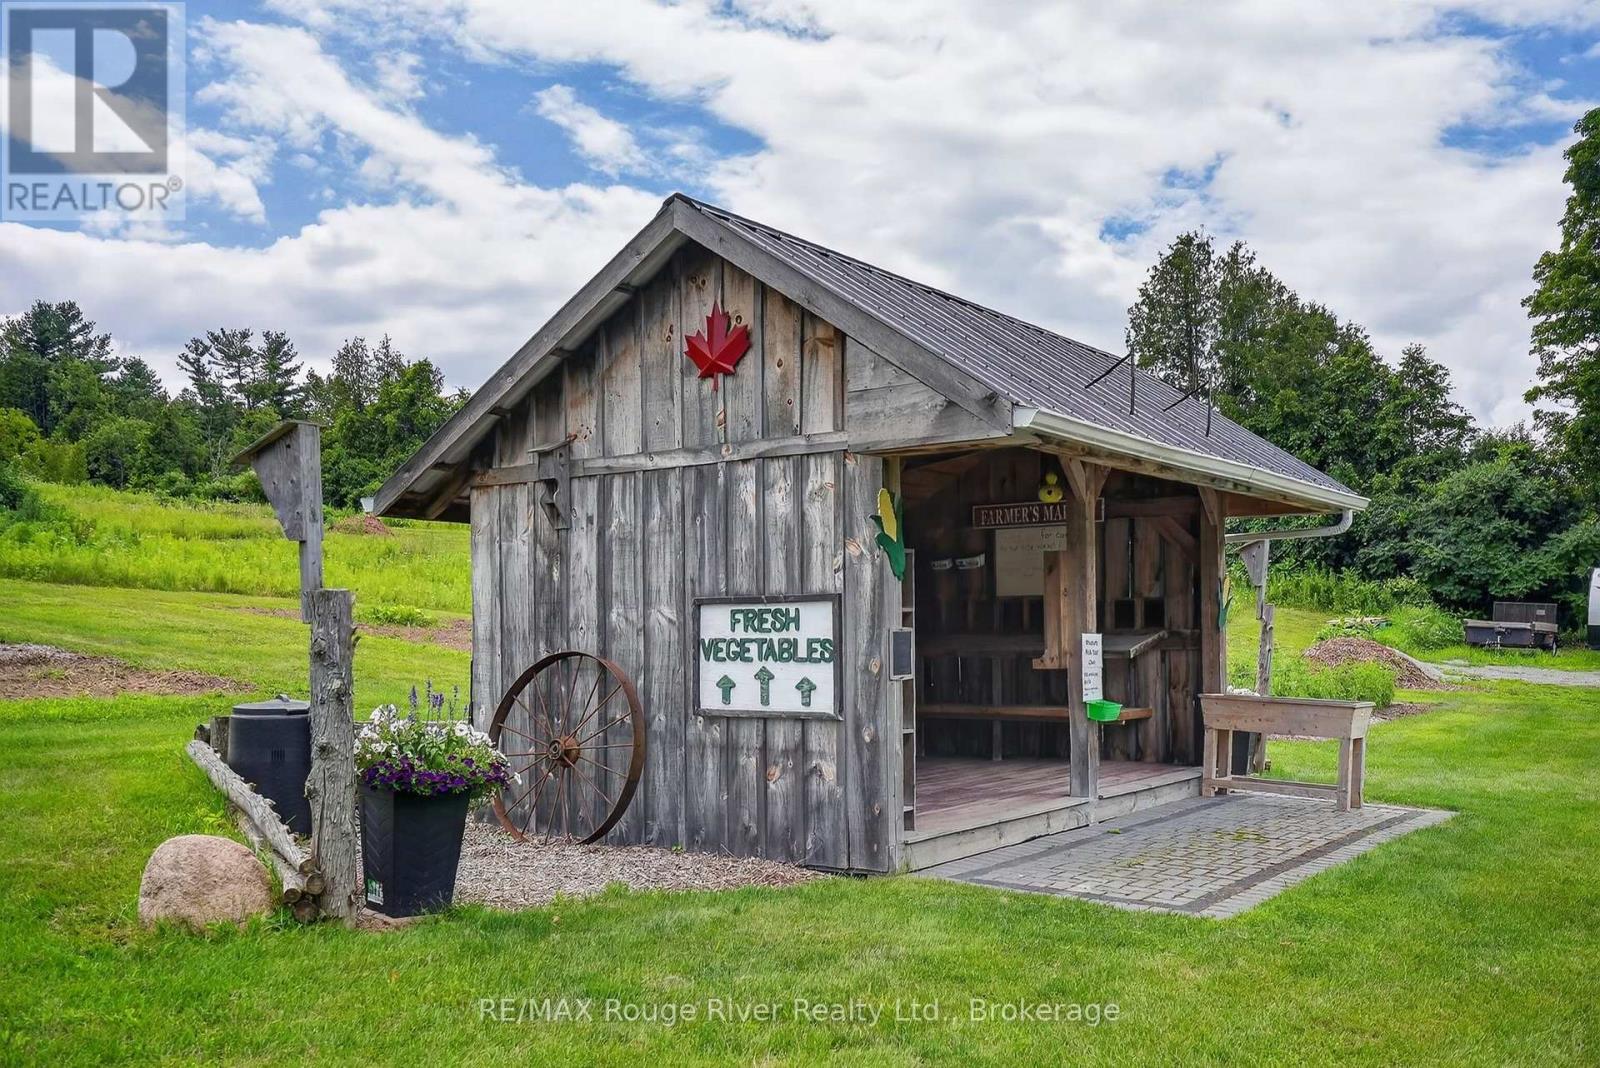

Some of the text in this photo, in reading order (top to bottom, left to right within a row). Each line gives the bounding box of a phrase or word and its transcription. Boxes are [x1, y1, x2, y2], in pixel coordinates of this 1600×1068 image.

[981, 505, 1040, 526] FARMER'S
[730, 607, 800, 633] FRESH
[700, 637, 834, 663] VEGETABLES
